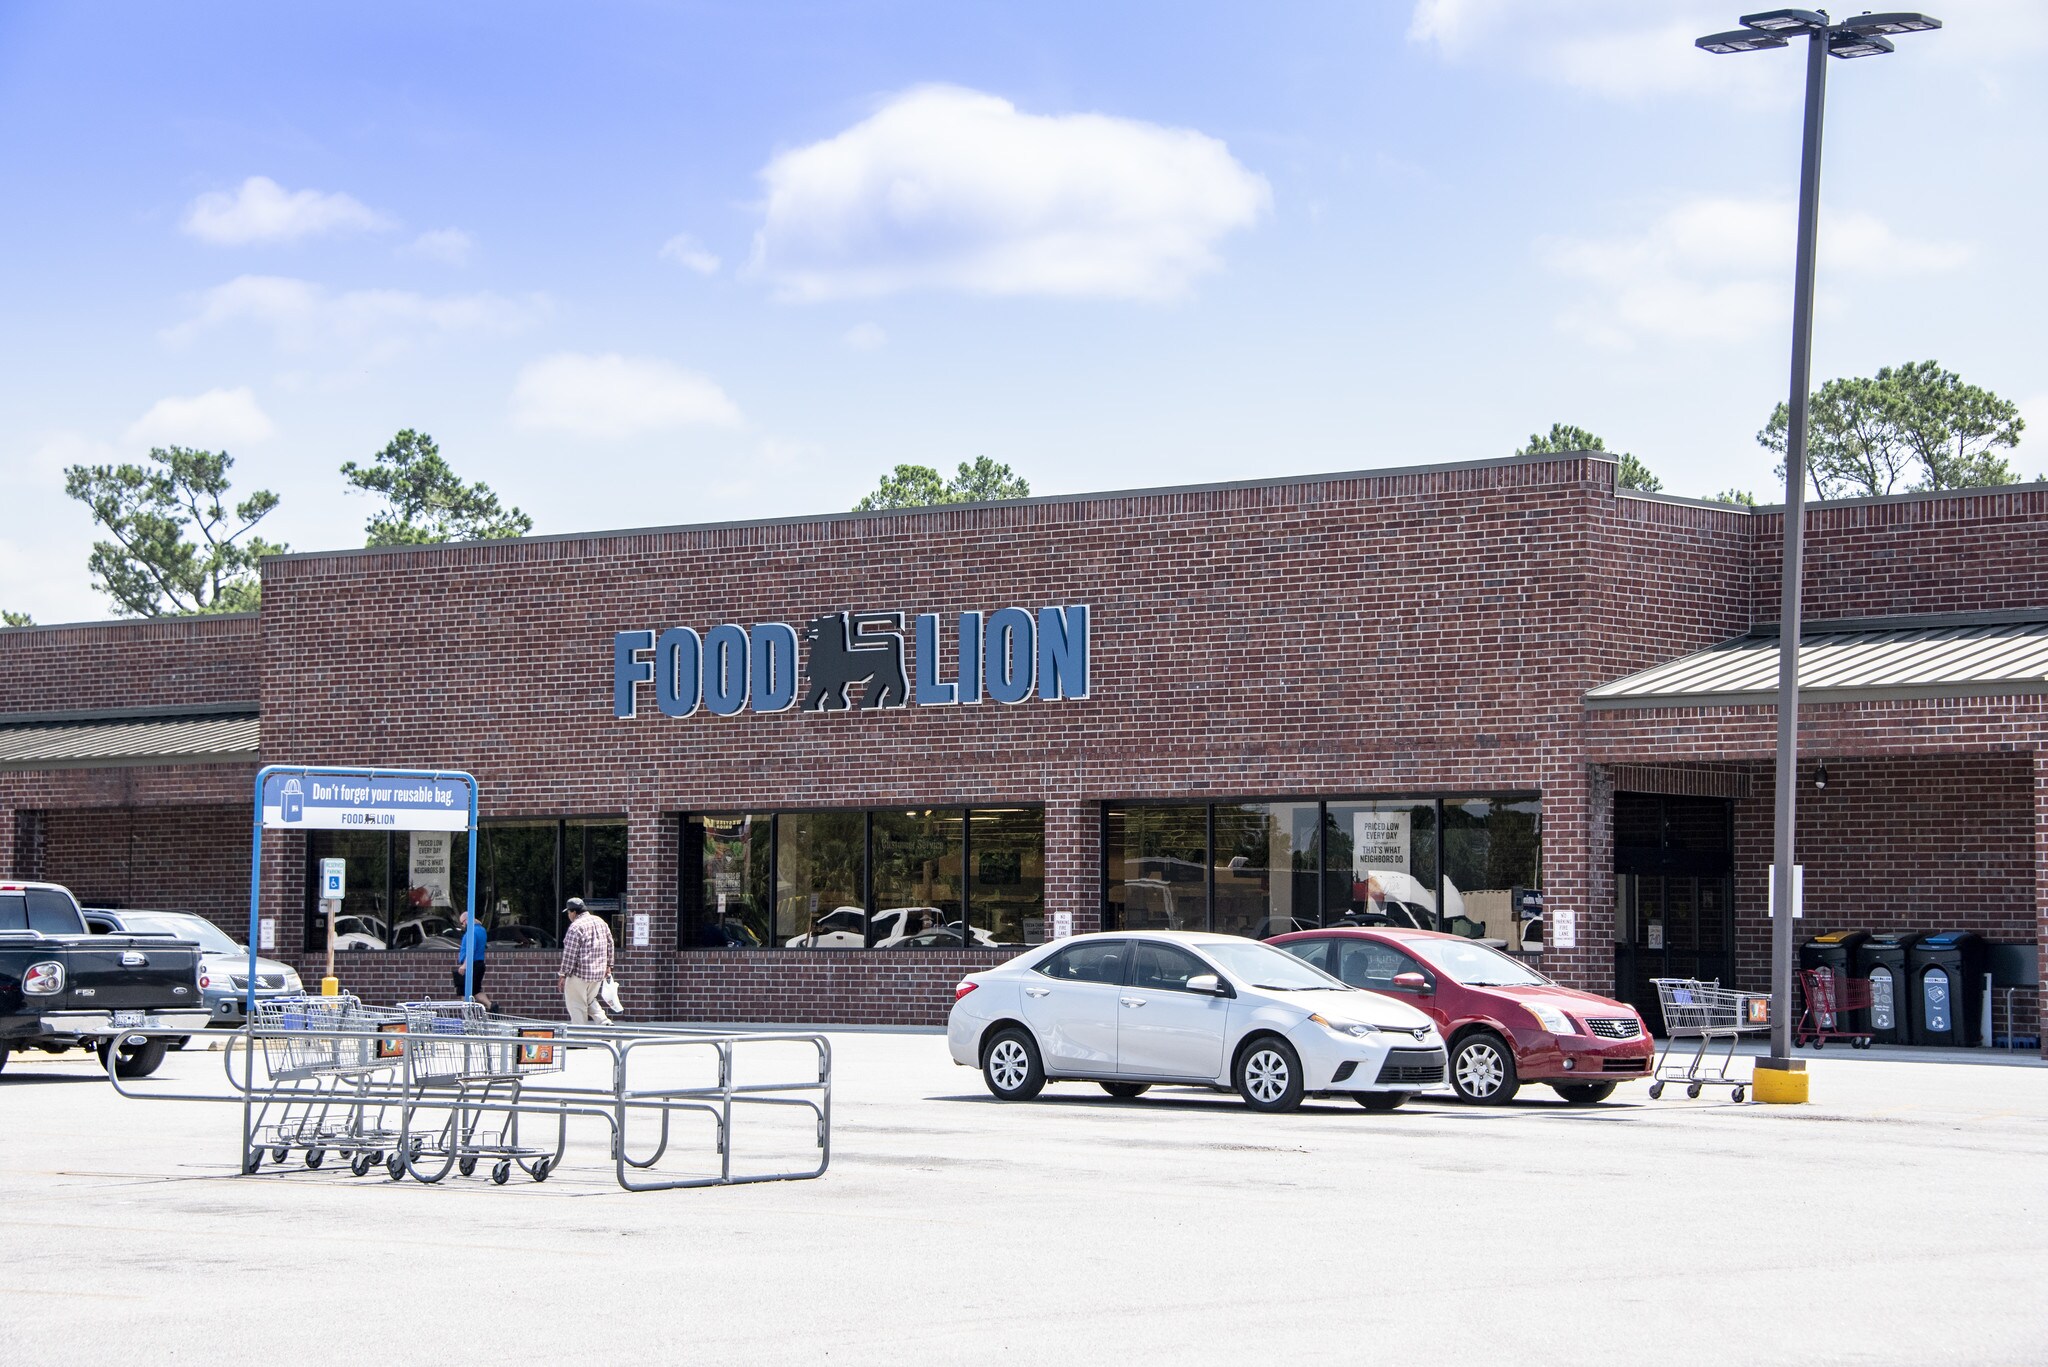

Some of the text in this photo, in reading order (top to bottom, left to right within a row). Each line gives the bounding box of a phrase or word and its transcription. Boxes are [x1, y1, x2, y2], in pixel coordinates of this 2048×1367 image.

[614, 604, 1090, 719] FOOD LION
[312, 783, 454, 807] Don't forget your reusable bag.
[341, 813, 395, 825] FOOD LION
[1363, 846, 1401, 854] THAT'S WHAT
[1360, 855, 1404, 863] NEIGHBORS DO
